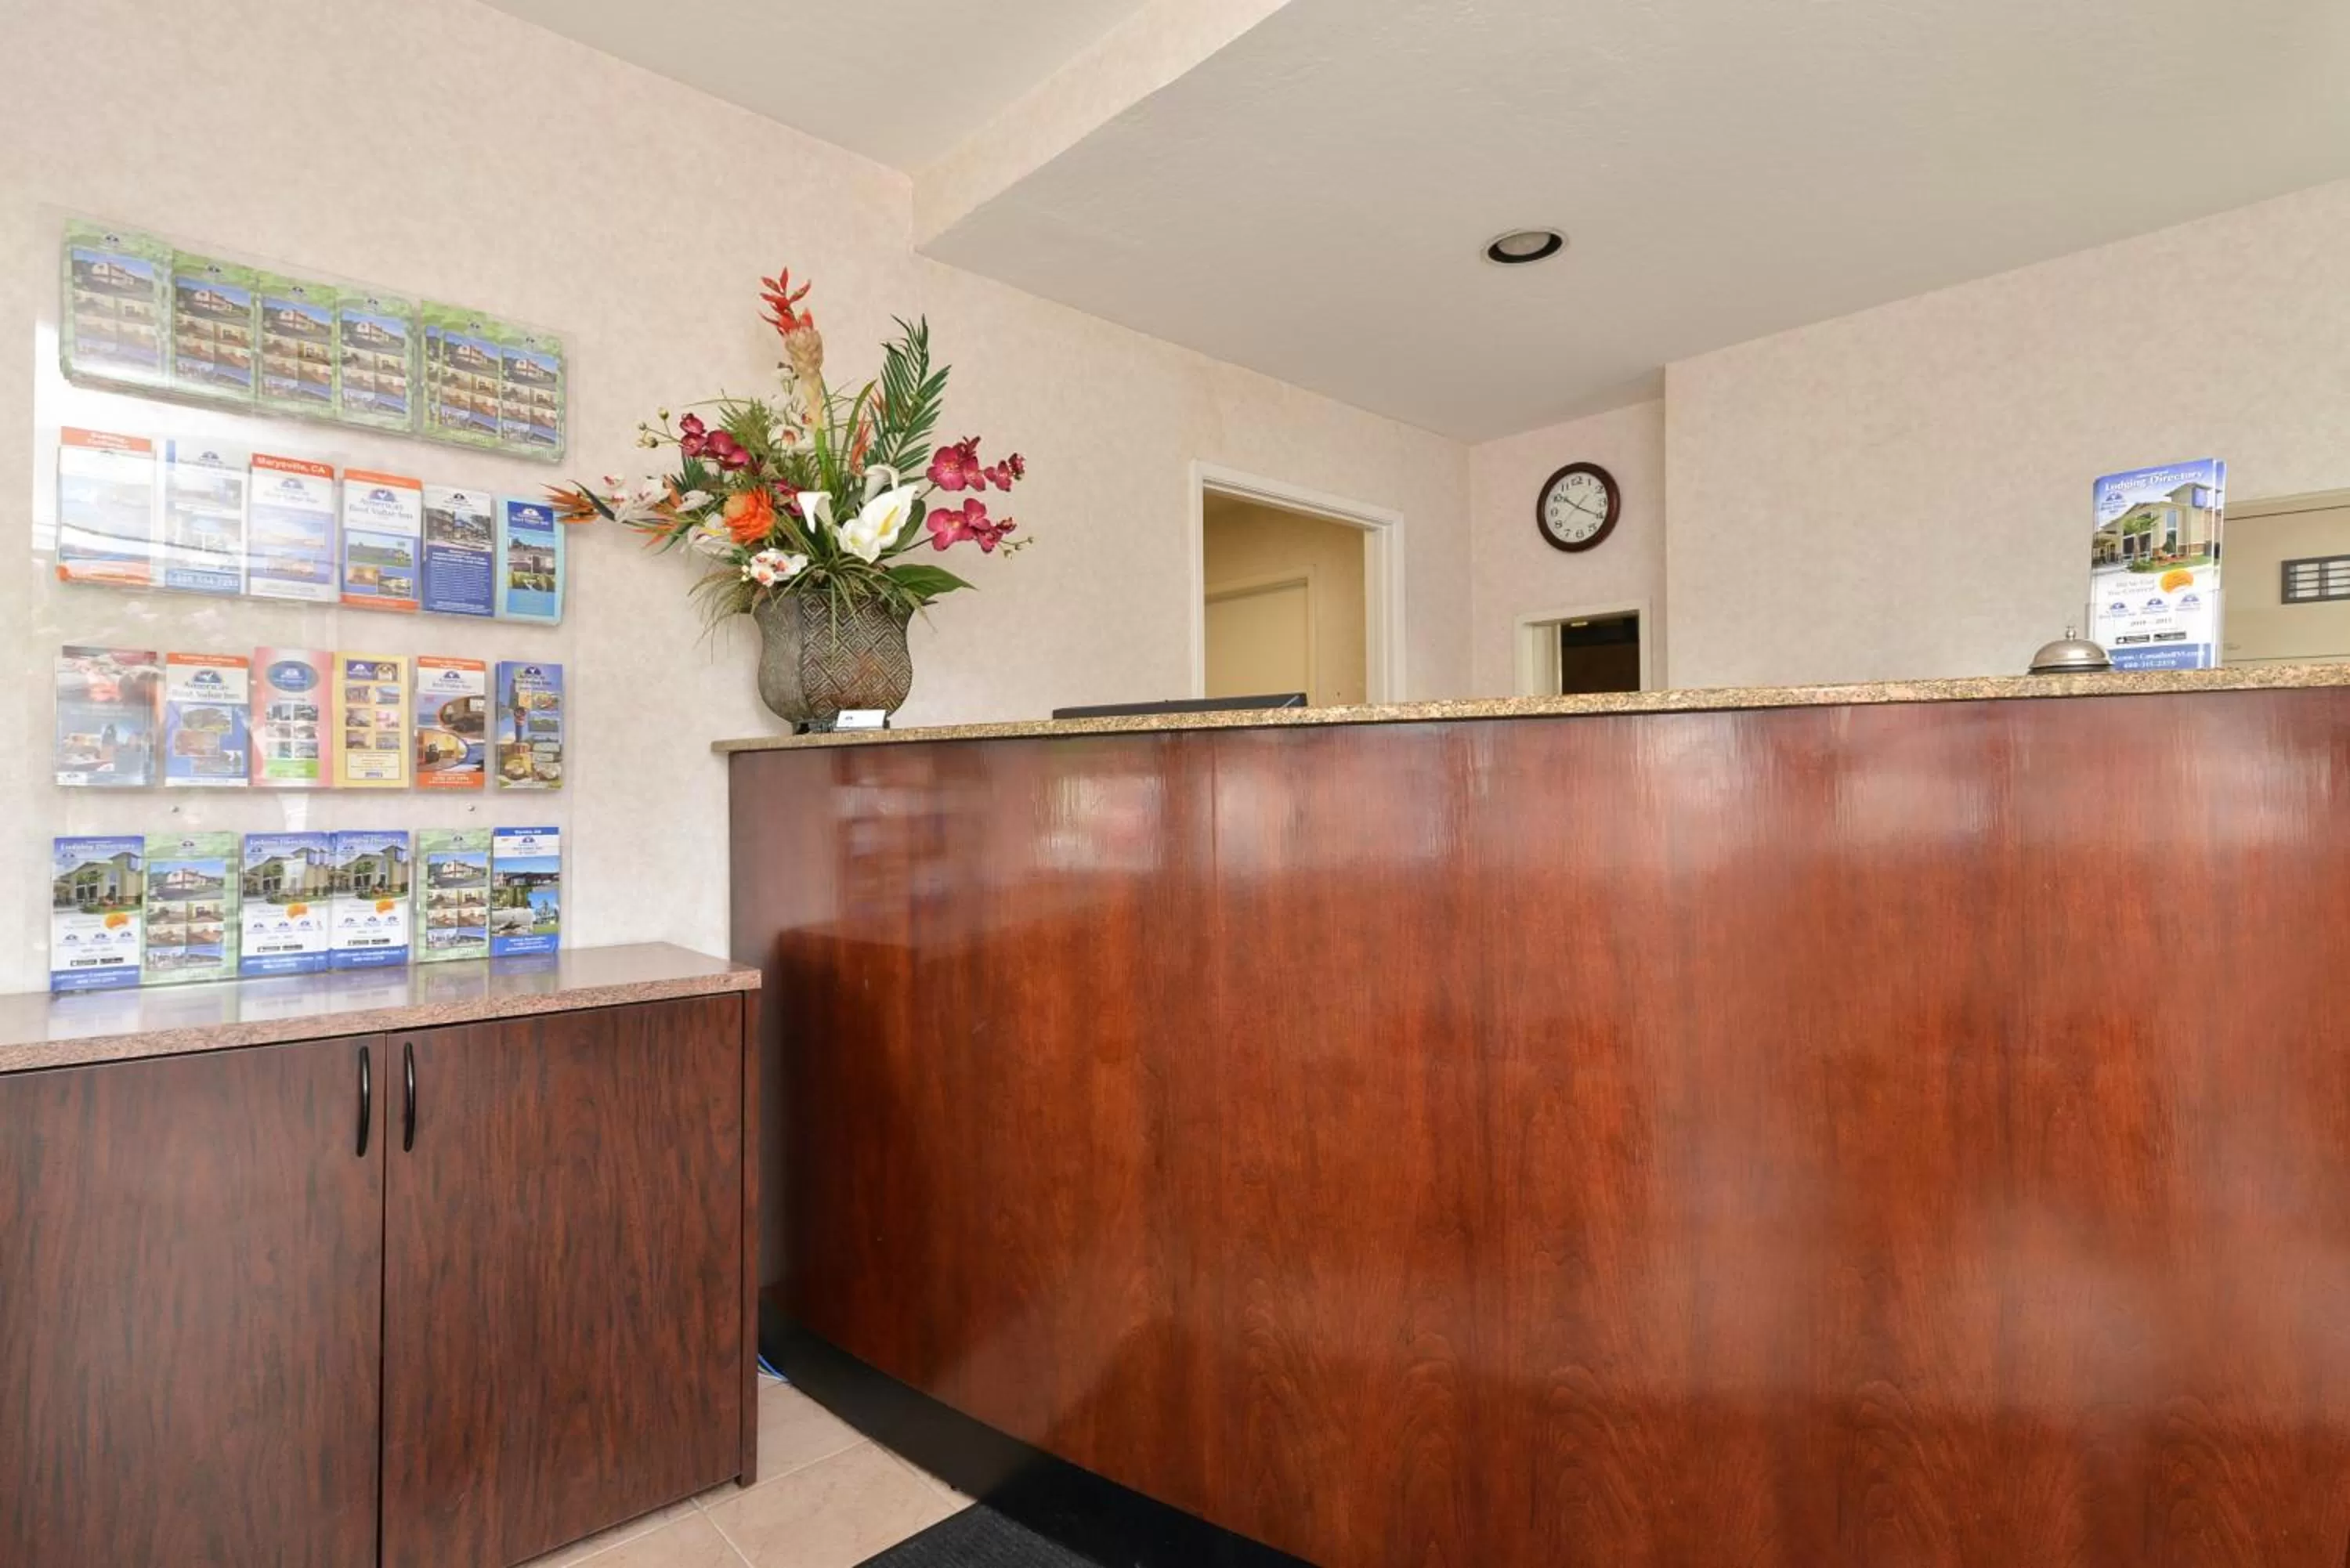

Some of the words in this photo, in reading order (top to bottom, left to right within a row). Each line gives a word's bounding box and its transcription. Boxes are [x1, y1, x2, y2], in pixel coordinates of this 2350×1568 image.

[1571, 475, 1583, 486] 12
[1561, 482, 1570, 493] 11
[1595, 486, 1604, 494] 2
[1554, 519, 1564, 529] 8
[1588, 522, 1597, 533] 5
[1564, 528, 1571, 538] 7
[1575, 529, 1585, 540] 6
